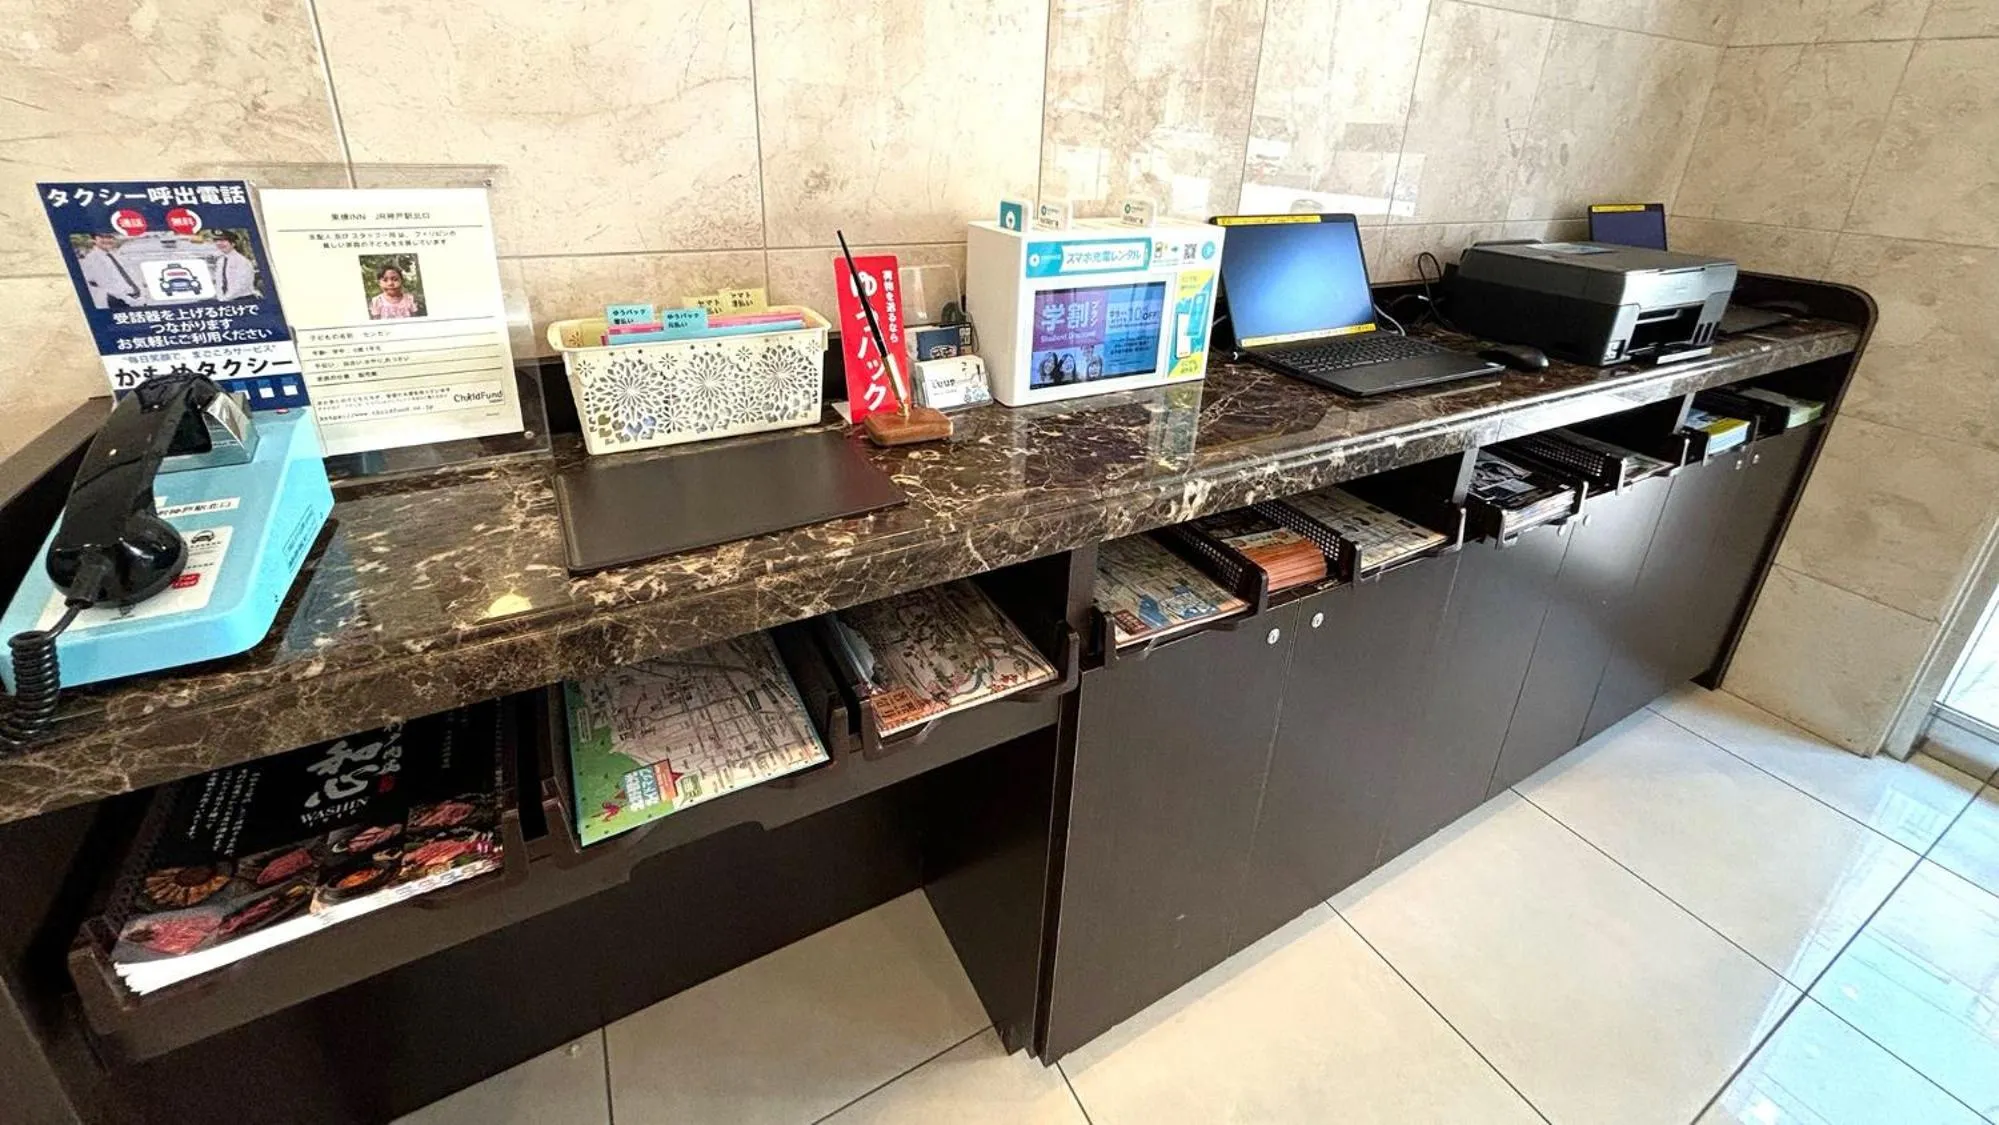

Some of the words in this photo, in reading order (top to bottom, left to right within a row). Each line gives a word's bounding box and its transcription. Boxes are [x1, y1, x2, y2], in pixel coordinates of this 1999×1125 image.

[47, 185, 247, 208] タクシー呼出電話
[1066, 248, 1142, 265] スマホ充電レンタル
[112, 304, 260, 325] 受話器を上げるだけで
[612, 308, 647, 317] ゆうパック
[667, 312, 700, 321] ゆうパック
[1040, 301, 1090, 335] 学割
[150, 318, 234, 334] つながります
[116, 328, 273, 351] お気軽にご利用ください
[300, 796, 371, 824] WASHIN
